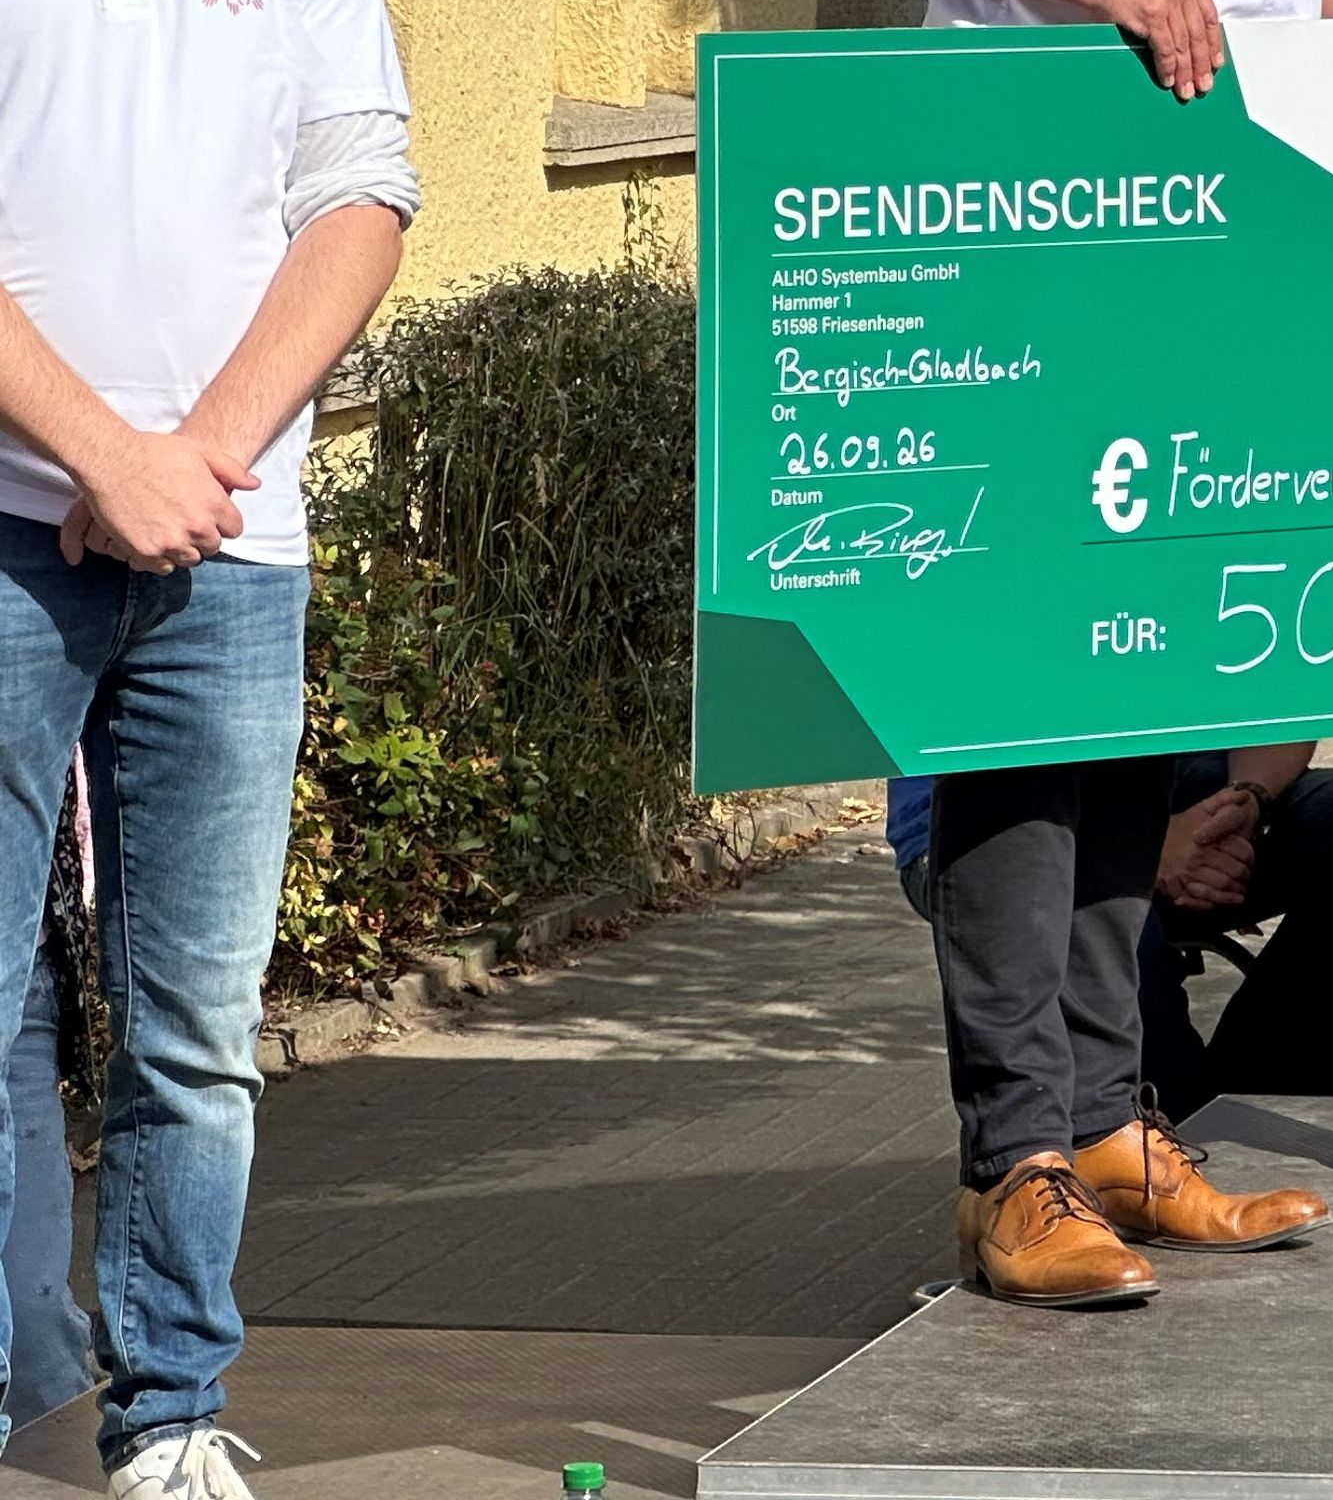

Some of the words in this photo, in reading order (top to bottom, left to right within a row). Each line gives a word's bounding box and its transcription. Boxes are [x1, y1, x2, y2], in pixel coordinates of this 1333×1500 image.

[773, 173, 1228, 242] SPENDENSCHECK
[771, 268, 818, 288] ALHO
[821, 266, 908, 288] Systembau
[911, 263, 960, 282] GmbH
[771, 293, 840, 312] Hammer
[844, 292, 851, 309] 1
[771, 318, 818, 336] 51598
[822, 315, 924, 334] Friesenhagen
[774, 344, 1041, 407] Bergisch-Gladbach
[771, 404, 797, 422] Ort
[1092, 437, 1149, 534] €
[771, 489, 823, 507] Datum
[770, 568, 861, 591] Unterschrift
[1091, 612, 1167, 656] FÜR:
